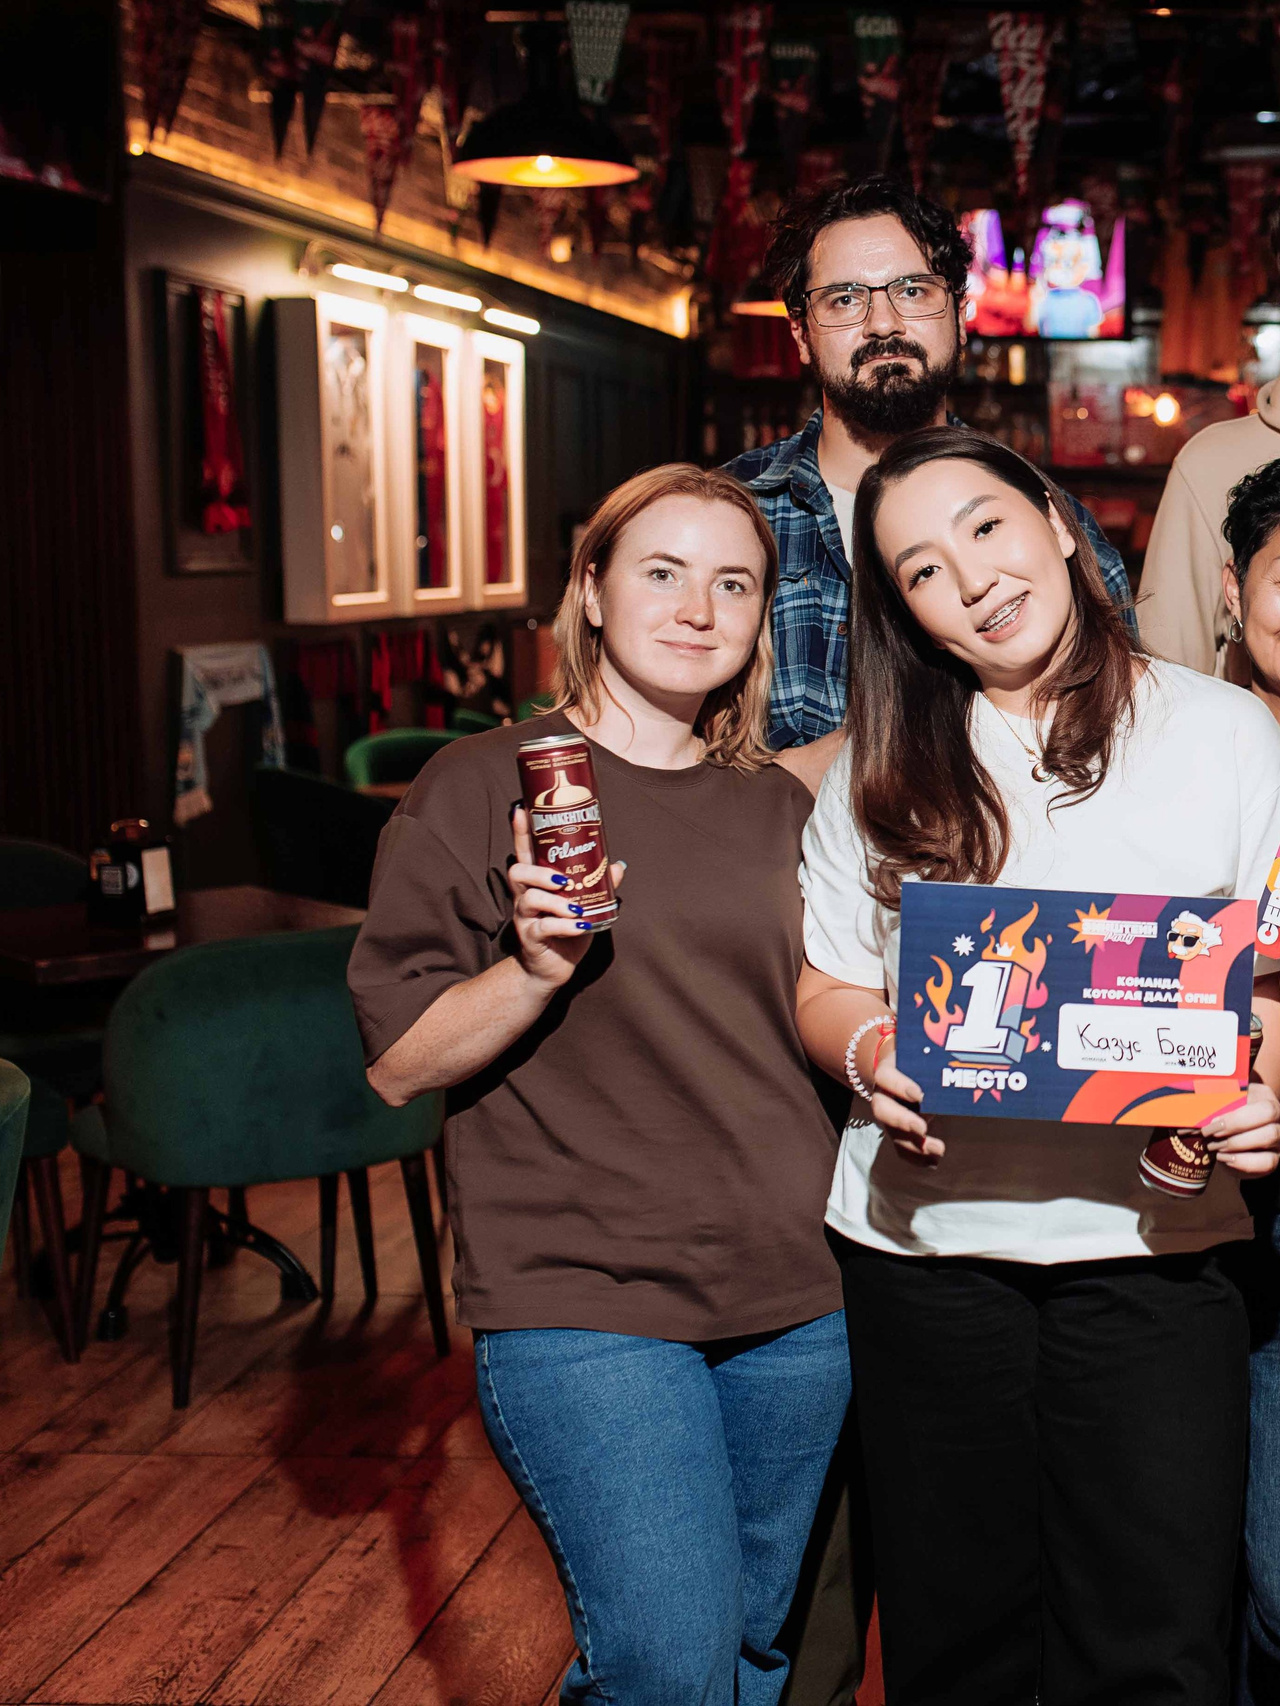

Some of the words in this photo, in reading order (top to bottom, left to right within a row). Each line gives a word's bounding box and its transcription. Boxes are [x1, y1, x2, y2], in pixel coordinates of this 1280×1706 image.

[547, 841, 597, 863] Pilsner
[1116, 975, 1185, 990] КОМАНДА,
[945, 960, 1011, 1054] 1
[1082, 988, 1143, 1001] КОТОРАЯ
[1144, 990, 1183, 1003] ДАЛА
[1184, 992, 1217, 1005] ОГНЯ
[1076, 1023, 1142, 1061] Казус
[1157, 1027, 1217, 1058] Белли
[942, 1067, 1028, 1092] МЕСТО
